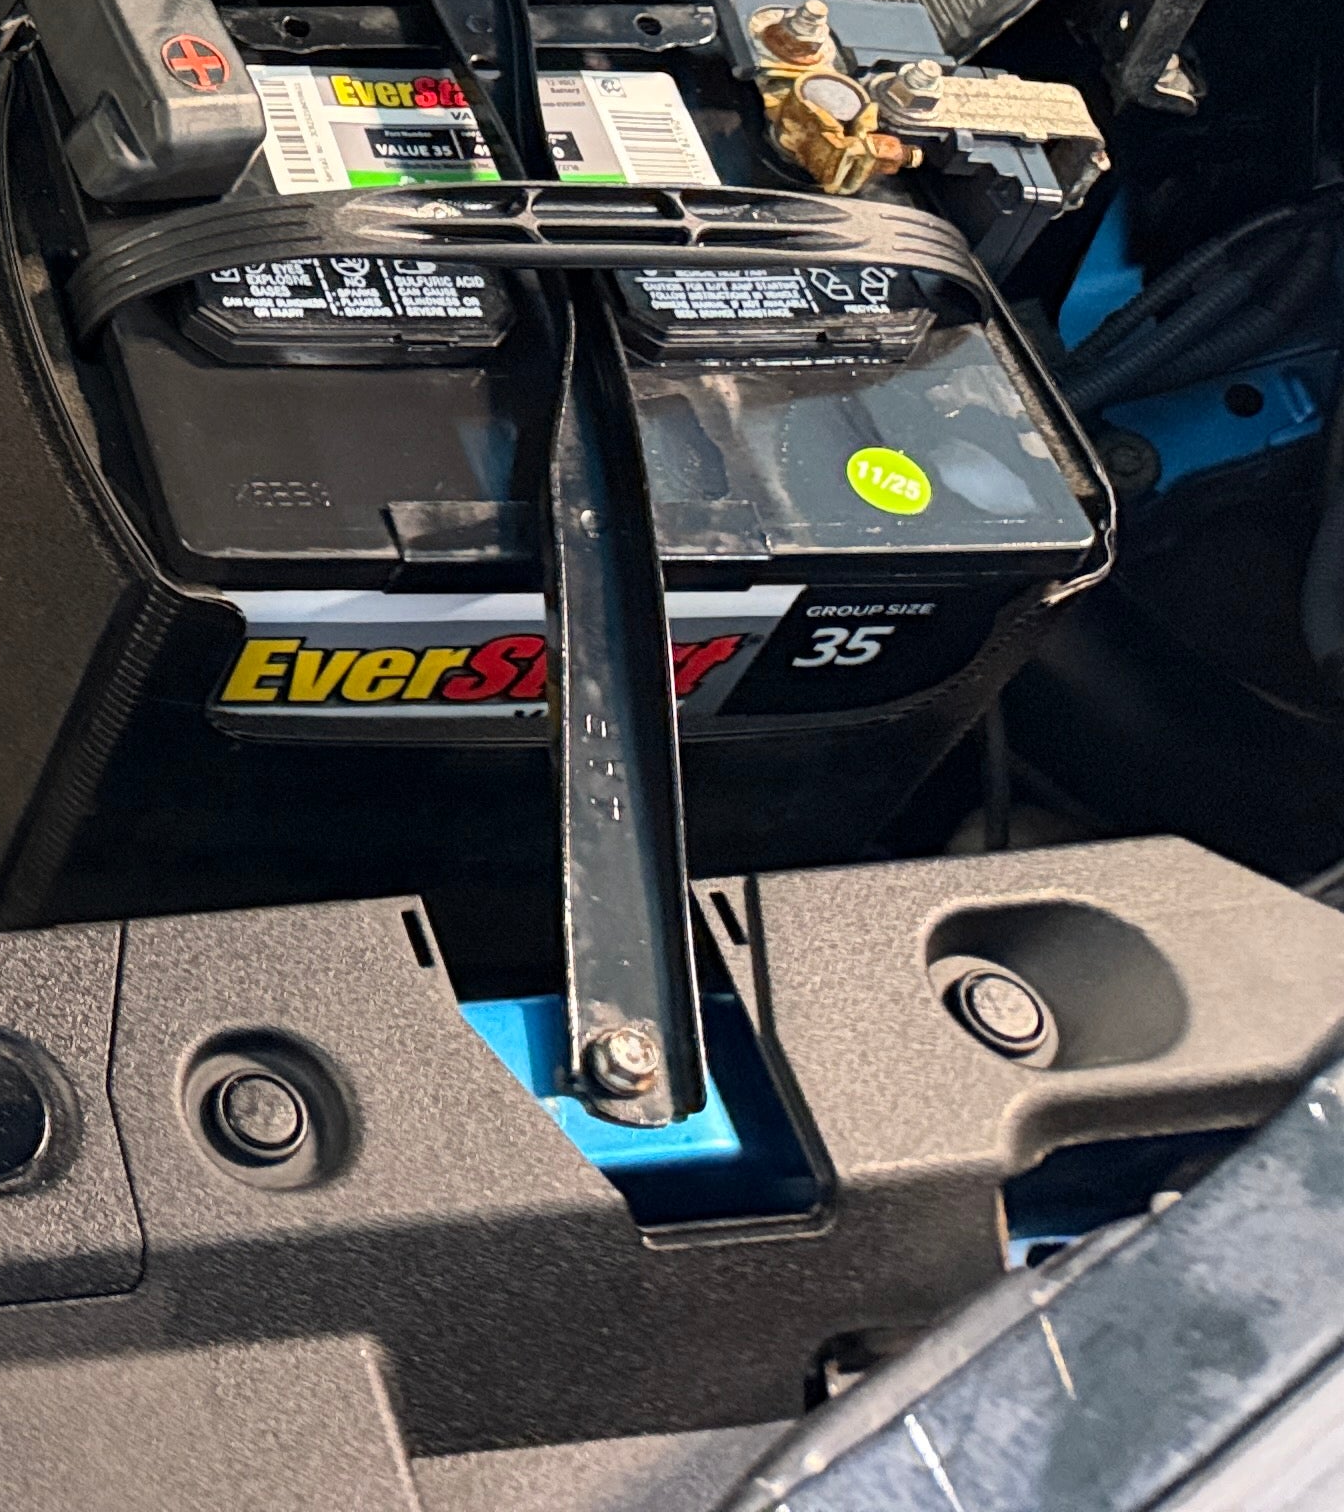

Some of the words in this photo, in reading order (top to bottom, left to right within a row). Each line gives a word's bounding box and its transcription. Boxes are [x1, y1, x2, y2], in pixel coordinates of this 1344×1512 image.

[375, 143, 428, 158] VALUE
[432, 144, 454, 158] 35
[246, 274, 312, 287] EXPLOSIVE
[344, 276, 367, 288] NO
[394, 276, 453, 288] SULFURIC
[455, 276, 485, 288] ACID
[843, 303, 891, 314] RECYCLE
[856, 460, 922, 502] 11/25
[806, 603, 885, 618] GROUP
[885, 602, 936, 616] SIZE
[791, 625, 896, 668] 35
